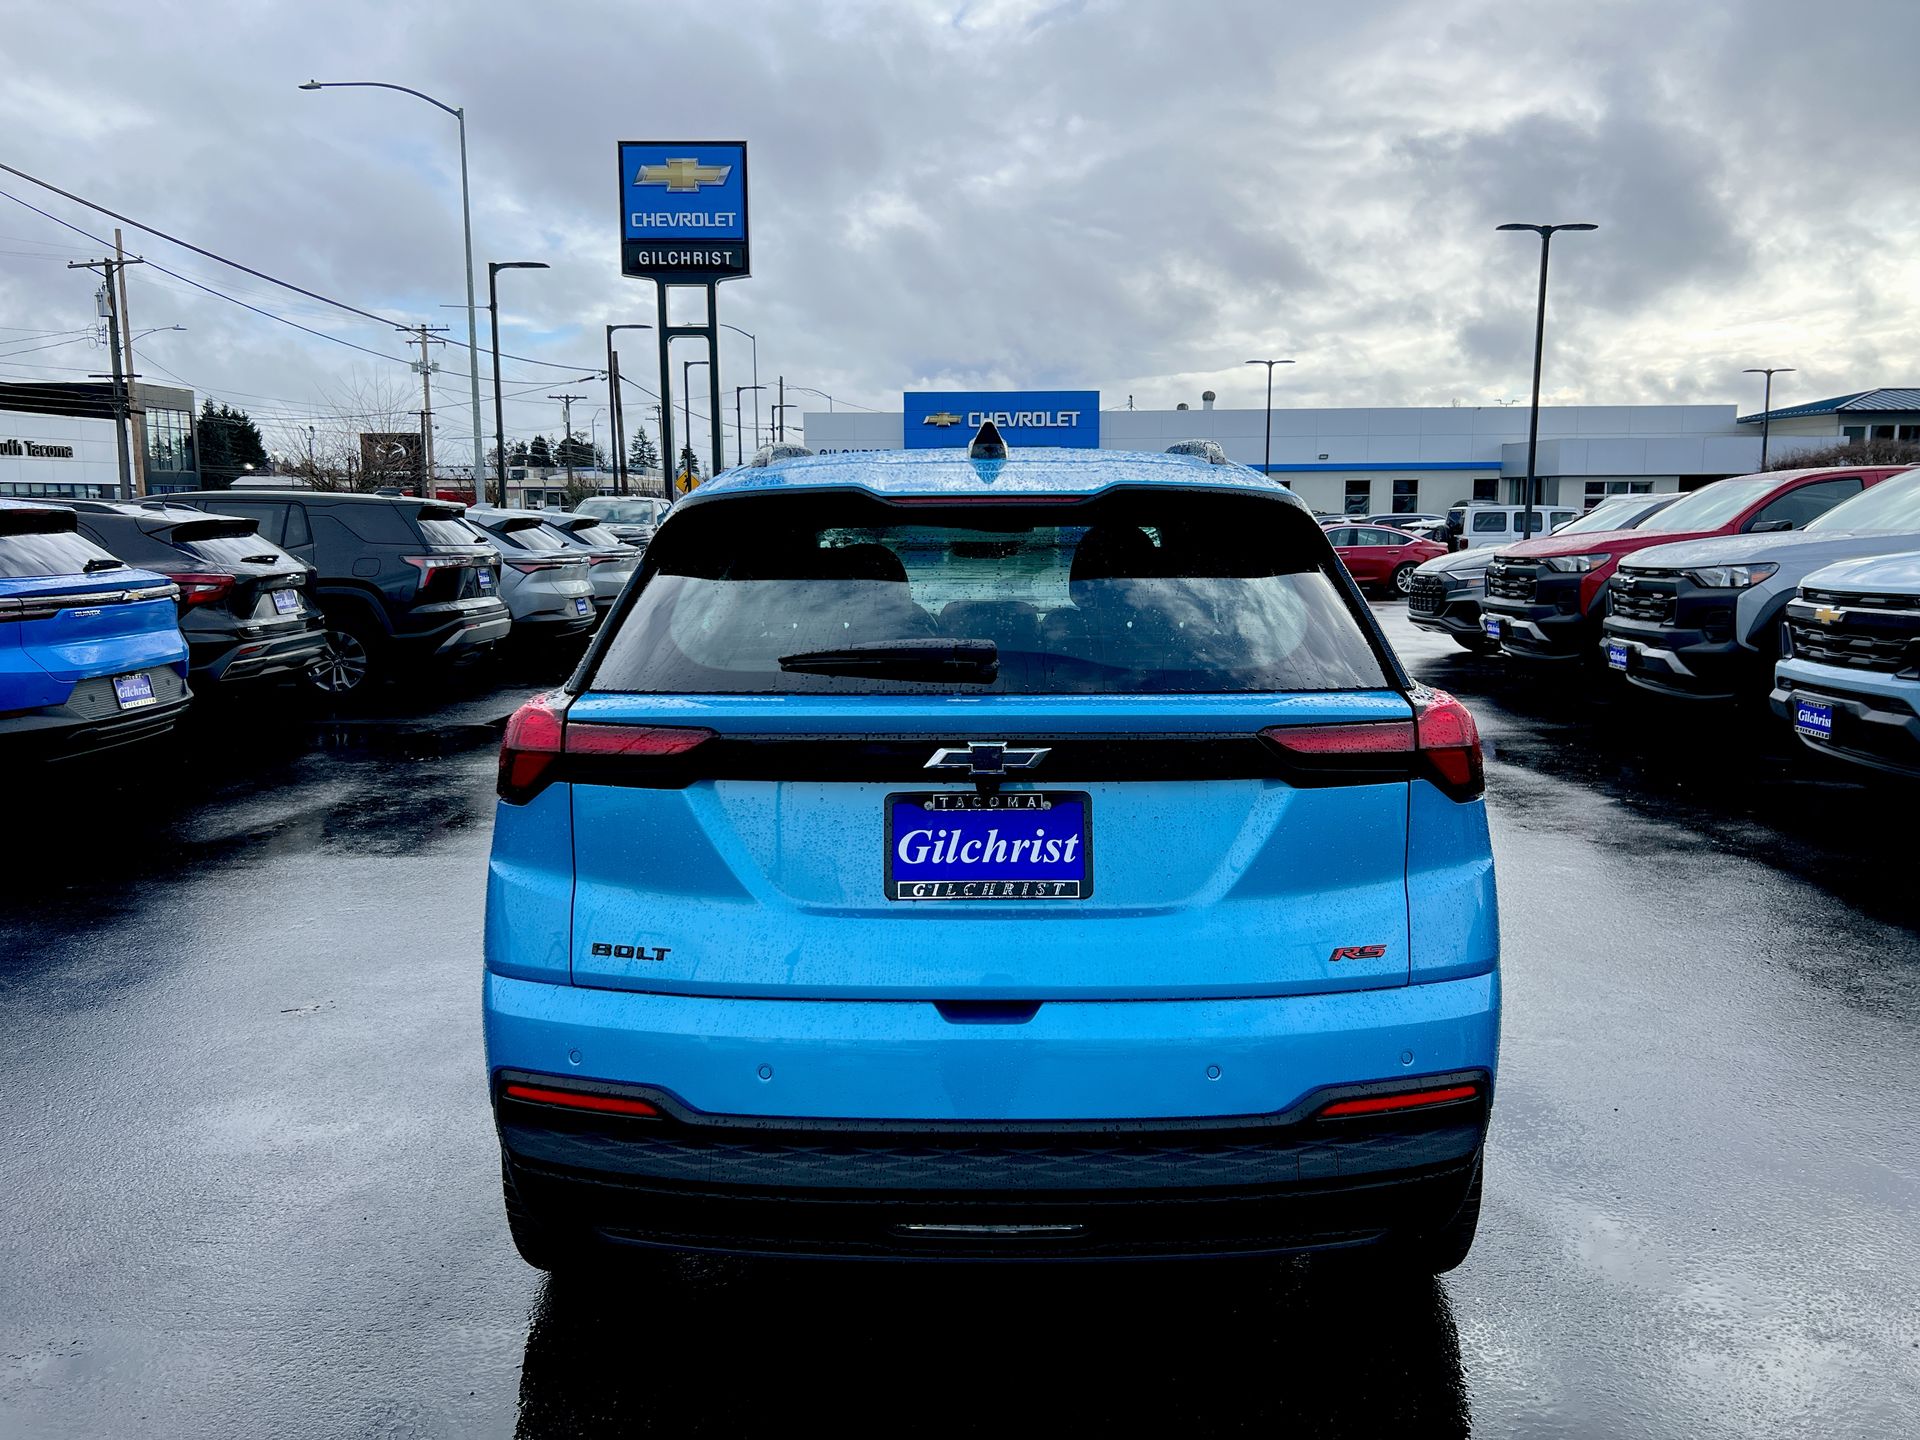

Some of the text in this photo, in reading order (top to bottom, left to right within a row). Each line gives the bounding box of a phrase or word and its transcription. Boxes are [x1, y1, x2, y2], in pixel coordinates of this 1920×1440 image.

[631, 212, 737, 227] CHEVROLET
[638, 251, 733, 265] GILCHRIST
[968, 411, 1080, 427] CHEVROLET
[24, 440, 74, 458] Tacoma
[118, 684, 151, 698] Gilchrist
[939, 796, 1037, 809] TACOMA
[898, 828, 1079, 864] Gilchrist
[912, 882, 1066, 897] GILCHRIST
[591, 942, 672, 962] BOLT
[1328, 944, 1387, 962] RS
